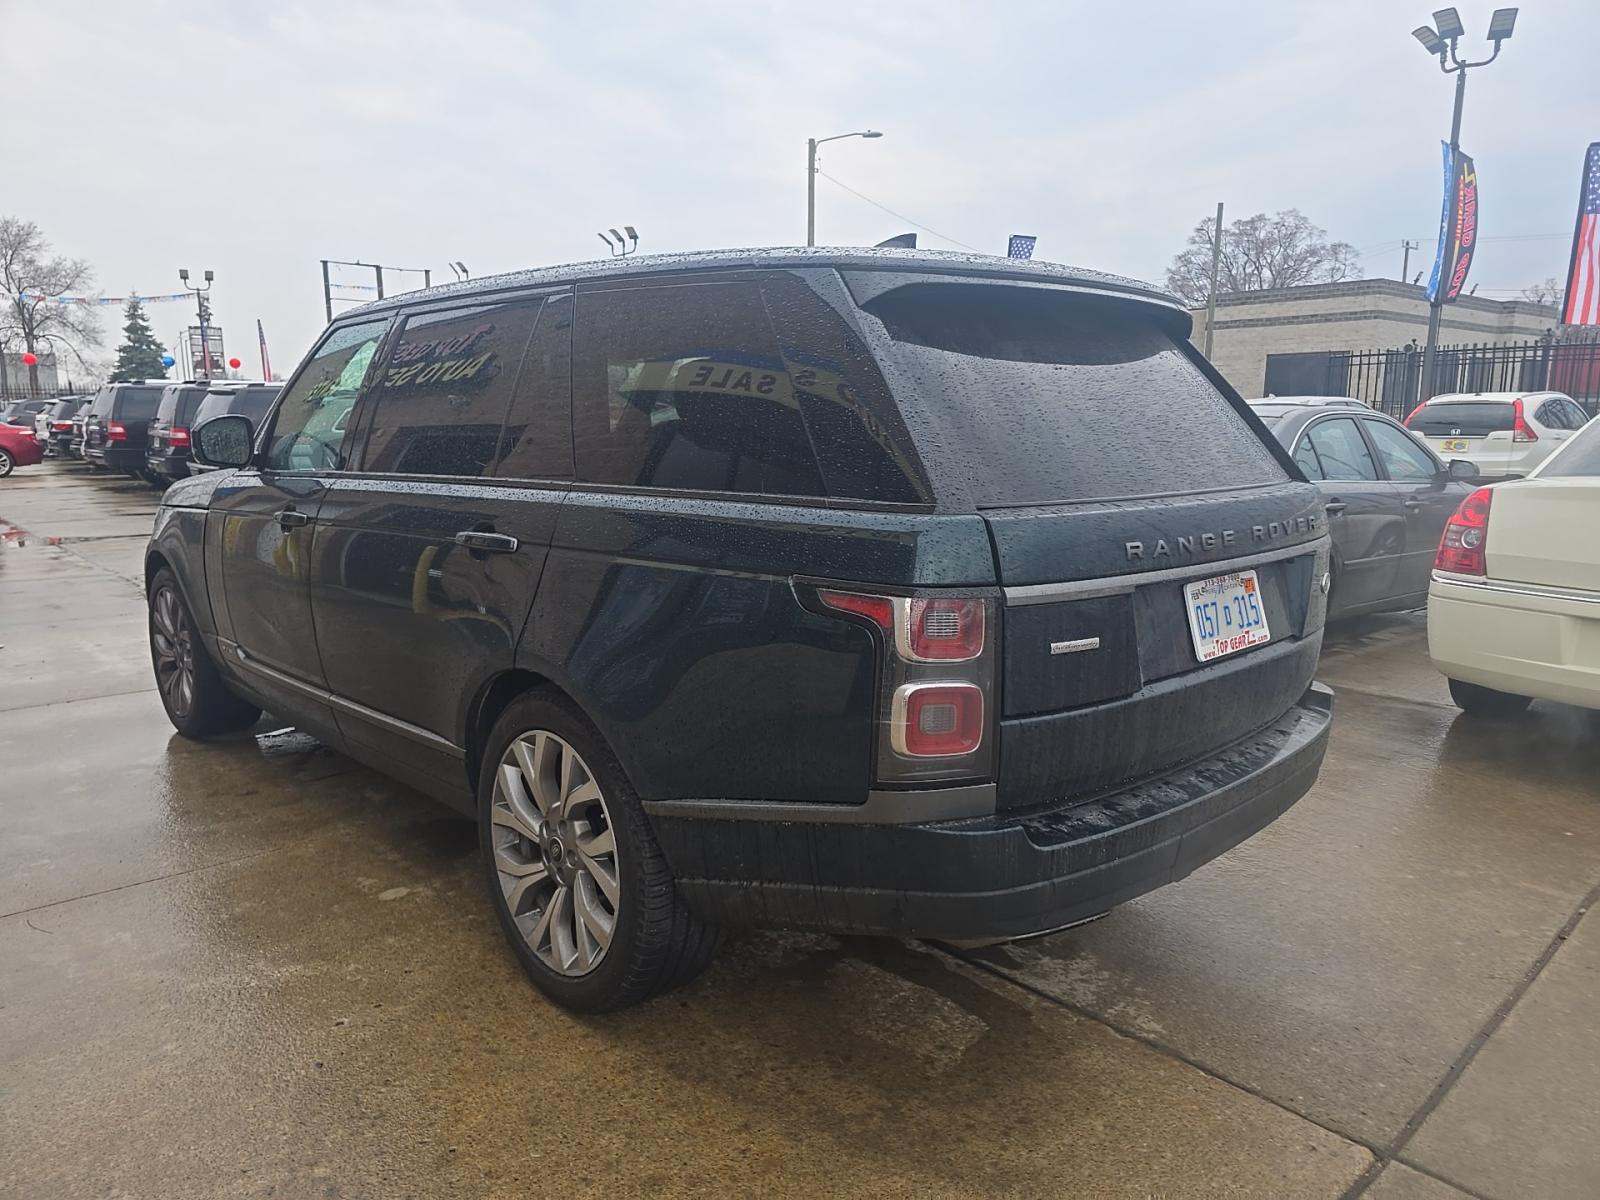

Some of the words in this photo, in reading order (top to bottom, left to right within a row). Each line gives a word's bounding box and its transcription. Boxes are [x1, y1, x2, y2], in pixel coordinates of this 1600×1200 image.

[1125, 530, 1236, 560] RANGE
[1251, 515, 1316, 541] ROVER
[1233, 593, 1260, 629] 315
